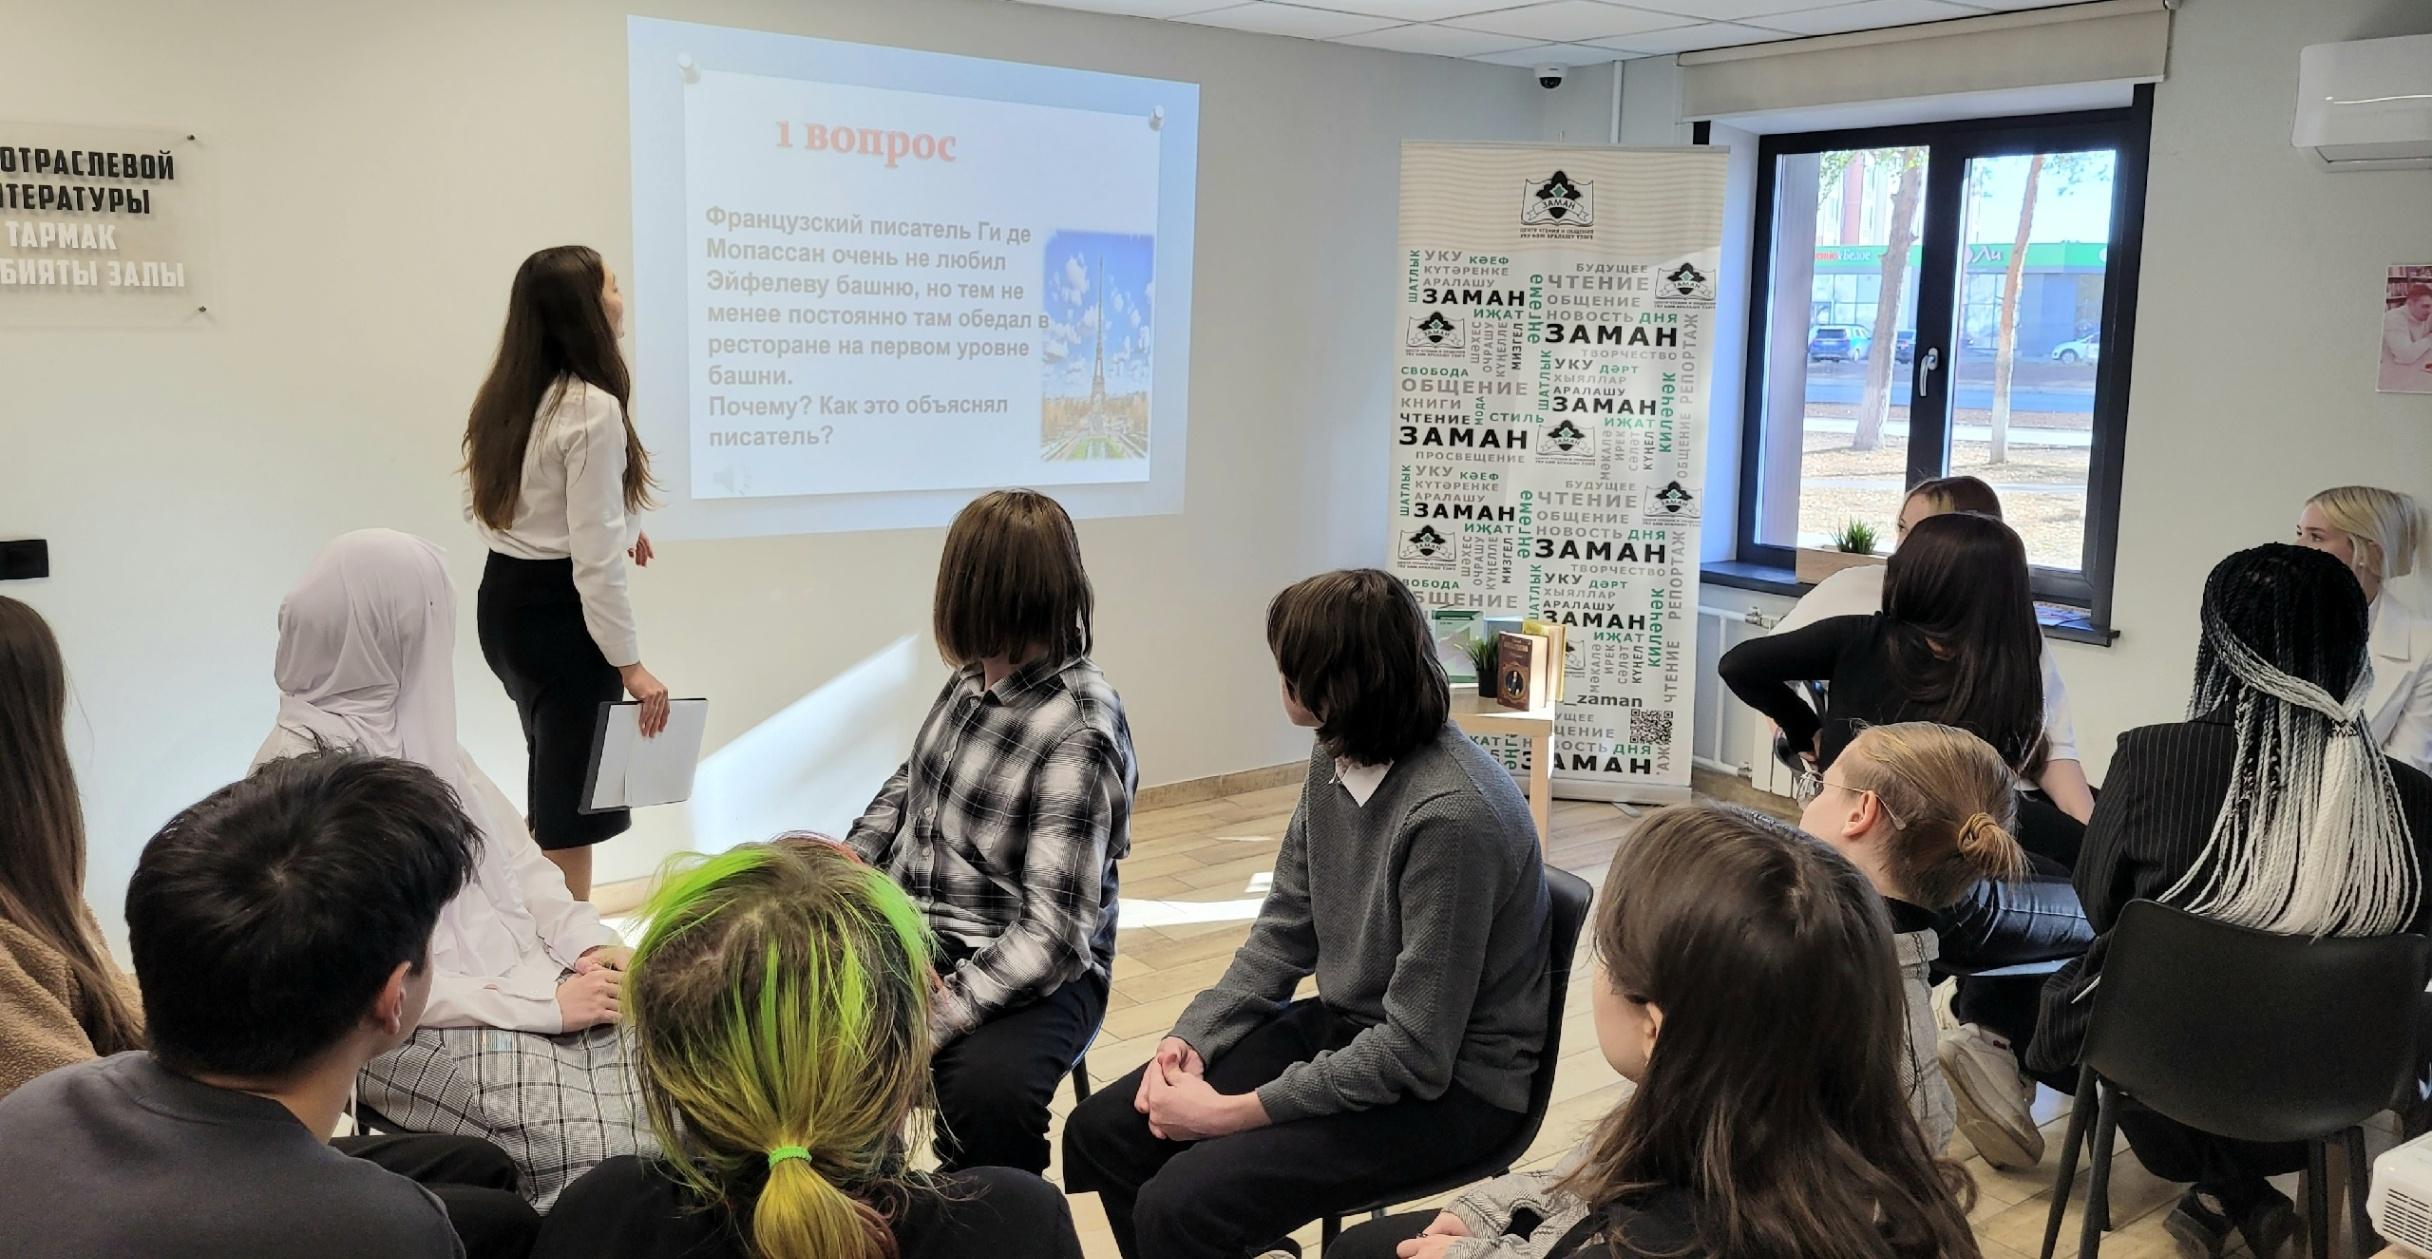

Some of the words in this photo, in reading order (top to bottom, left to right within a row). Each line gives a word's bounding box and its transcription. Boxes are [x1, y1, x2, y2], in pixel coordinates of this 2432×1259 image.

[776, 120, 793, 148] 1
[804, 123, 957, 168] вопрос
[1543, 199, 1576, 210] ЗАМАН
[5, 220, 117, 250] ТАРМАК
[706, 206, 863, 235] Французский
[870, 219, 971, 240] писатель
[978, 221, 1001, 241] Ги
[1007, 228, 1031, 245] де
[706, 237, 825, 263] Мопассан
[832, 248, 898, 266] очень
[906, 252, 930, 267] не
[936, 251, 1006, 271] любил
[1424, 250, 1462, 262] УКУ
[1469, 256, 1509, 265] КӘЕФ
[107, 260, 185, 287] ЗАЛЫ
[1408, 249, 1420, 303] ШАТЛЫК
[1576, 263, 1649, 274] БУДУЩЕЕ
[706, 269, 829, 299] Эйфелеву
[836, 274, 919, 299] башню,
[927, 282, 951, 297] но
[957, 283, 995, 299] тем
[1001, 285, 1024, 300] не
[1423, 278, 1495, 288] АРАЛАШУ
[1548, 275, 1649, 291] ЧТЕНИЕ
[1422, 288, 1525, 306] ЗАМАН
[1547, 294, 1641, 308] ОБЩЕНИЕ
[708, 306, 781, 323] менее
[788, 308, 907, 326] постоянно
[913, 311, 951, 326] там
[958, 309, 1031, 330] обедал
[1039, 315, 1049, 329] в
[1547, 310, 1634, 323] НОВОСТЬ
[1639, 312, 1678, 324] ДНЯ
[1471, 321, 1481, 364] ШӘХЕС
[1545, 323, 1677, 347] ЗАМАН
[708, 337, 831, 358] ресторане
[838, 339, 864, 355] на
[871, 339, 951, 359] первом
[956, 342, 1029, 360] уровне
[1483, 321, 1494, 372] ОЧРАШУ
[1512, 323, 1523, 370] МИЗГЕЛ
[1581, 349, 1677, 360] ТВОРЧЕСТВО
[1554, 358, 1593, 370] УКУ
[1600, 365, 1639, 374] ДӘРТ
[1680, 314, 1698, 405] РЕПОРТАЖ
[708, 365, 793, 385] башни.
[1401, 367, 1469, 378] СВОБОДА
[1538, 350, 1552, 410] ШАТЛЫК
[1554, 374, 1627, 384] ХЫЯЛЛАР
[1402, 378, 1528, 396] ОБЩЕНИЕ
[1553, 386, 1626, 396] АРАЛАШУ
[709, 395, 812, 420] Почему?
[820, 395, 858, 415] Как
[864, 399, 900, 414] это
[906, 395, 1008, 414] объяснял
[1401, 398, 1461, 409] КНИГИ
[1475, 396, 1485, 425] МОДА
[1552, 396, 1656, 415] ЗАМАН
[1659, 372, 1676, 453] КИЛӘЧӘК
[1400, 413, 1470, 425] ЧТЕНИЕ
[1490, 413, 1544, 423] СТИЛЬ
[709, 425, 834, 447] писатель?
[1399, 426, 1527, 449] ЗАМАН
[1616, 431, 1625, 461] ИРЕК
[1677, 413, 1691, 478] ОБЩЕНИЕ
[1416, 452, 1525, 463] ПРОСВЕЩЕНИЕ
[1416, 466, 1453, 476] УКУ
[1460, 472, 1499, 480] КӘЕФ
[1400, 465, 1411, 516] ШАТЛЫК
[1565, 481, 1637, 492] БУДУЩЕЕ
[1415, 492, 1486, 502] АРАЛАШУ
[1538, 492, 1638, 508] ЧТЕНИЕ
[1414, 503, 1515, 521] ЗАМАН
[1537, 511, 1629, 524] ОБЩЕНИЕ
[1537, 526, 1623, 539] НОВОСТЬ
[1627, 529, 1666, 541] ДНЯ
[1461, 536, 1472, 576] ШӘХЕС
[1473, 536, 1485, 586] ОЧРАШУ
[1502, 538, 1513, 584] МИЗГЕЛ
[1535, 539, 1666, 563] ЗАМАН
[1571, 564, 1666, 576] ТВОРЧЕСТВО
[1668, 531, 1685, 619] РЕПОРТАЖ
[1404, 579, 1460, 590] ВОБОДА
[1544, 573, 1583, 584] УКУ
[1589, 580, 1628, 589] ДӘРТ
[1415, 591, 1518, 609] БЩЕНИЕ
[1543, 588, 1616, 599] ХЫЯЛЛАР
[1543, 601, 1615, 611] АРАЛАШУ
[1543, 610, 1645, 630] ЗАМАН
[1648, 588, 1665, 667] КИЛӘЧӘК
[1590, 644, 1601, 693] МӘКАЛӘ
[1604, 644, 1615, 674] ИРЕК
[1618, 645, 1629, 684] СӘЛӘТ
[1664, 640, 1680, 703] ЧТЕНИЕ
[1613, 744, 1650, 755] ДНЯ
